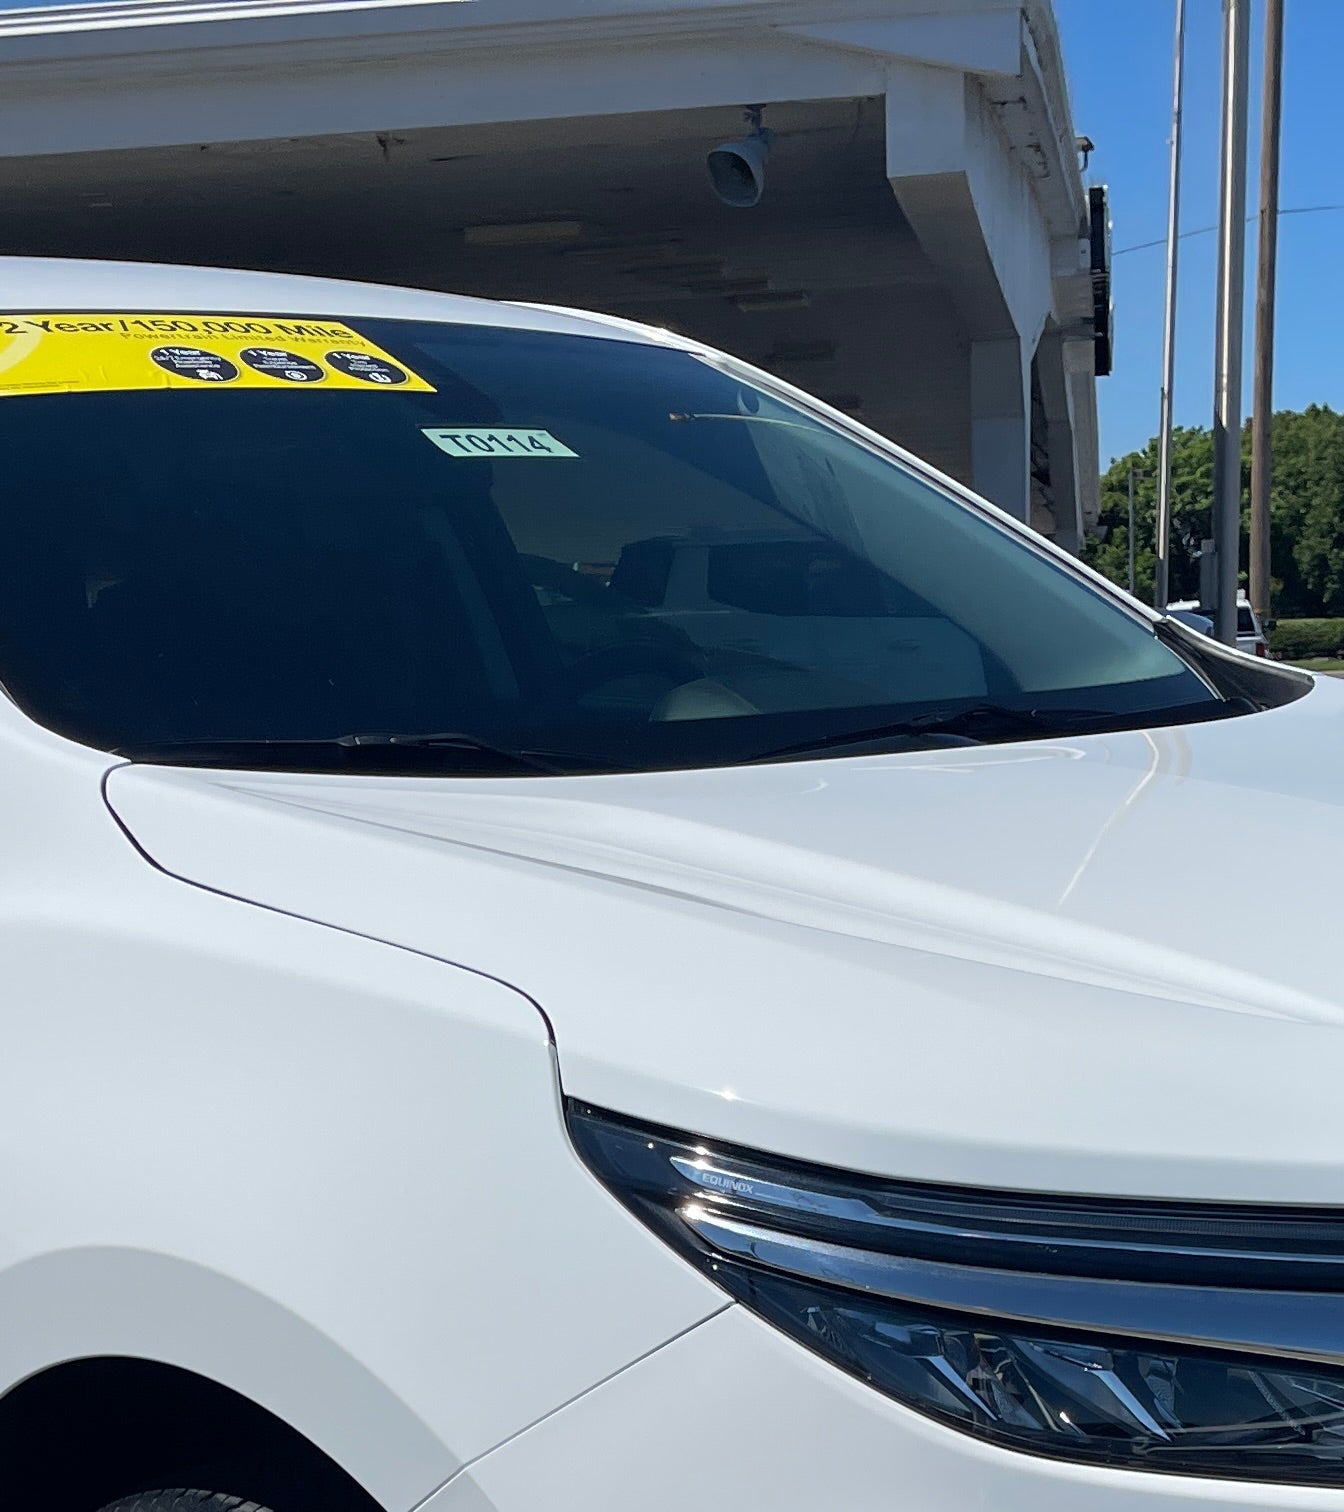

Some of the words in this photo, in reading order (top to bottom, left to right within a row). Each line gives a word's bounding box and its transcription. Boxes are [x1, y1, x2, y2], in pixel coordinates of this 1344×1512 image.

[120, 332, 220, 341] Powertrain
[221, 334, 285, 342] Limited
[291, 336, 366, 347] Warranty
[273, 323, 354, 339] Mile
[439, 434, 554, 453] T0114
[702, 1172, 754, 1195] EQUINOX
